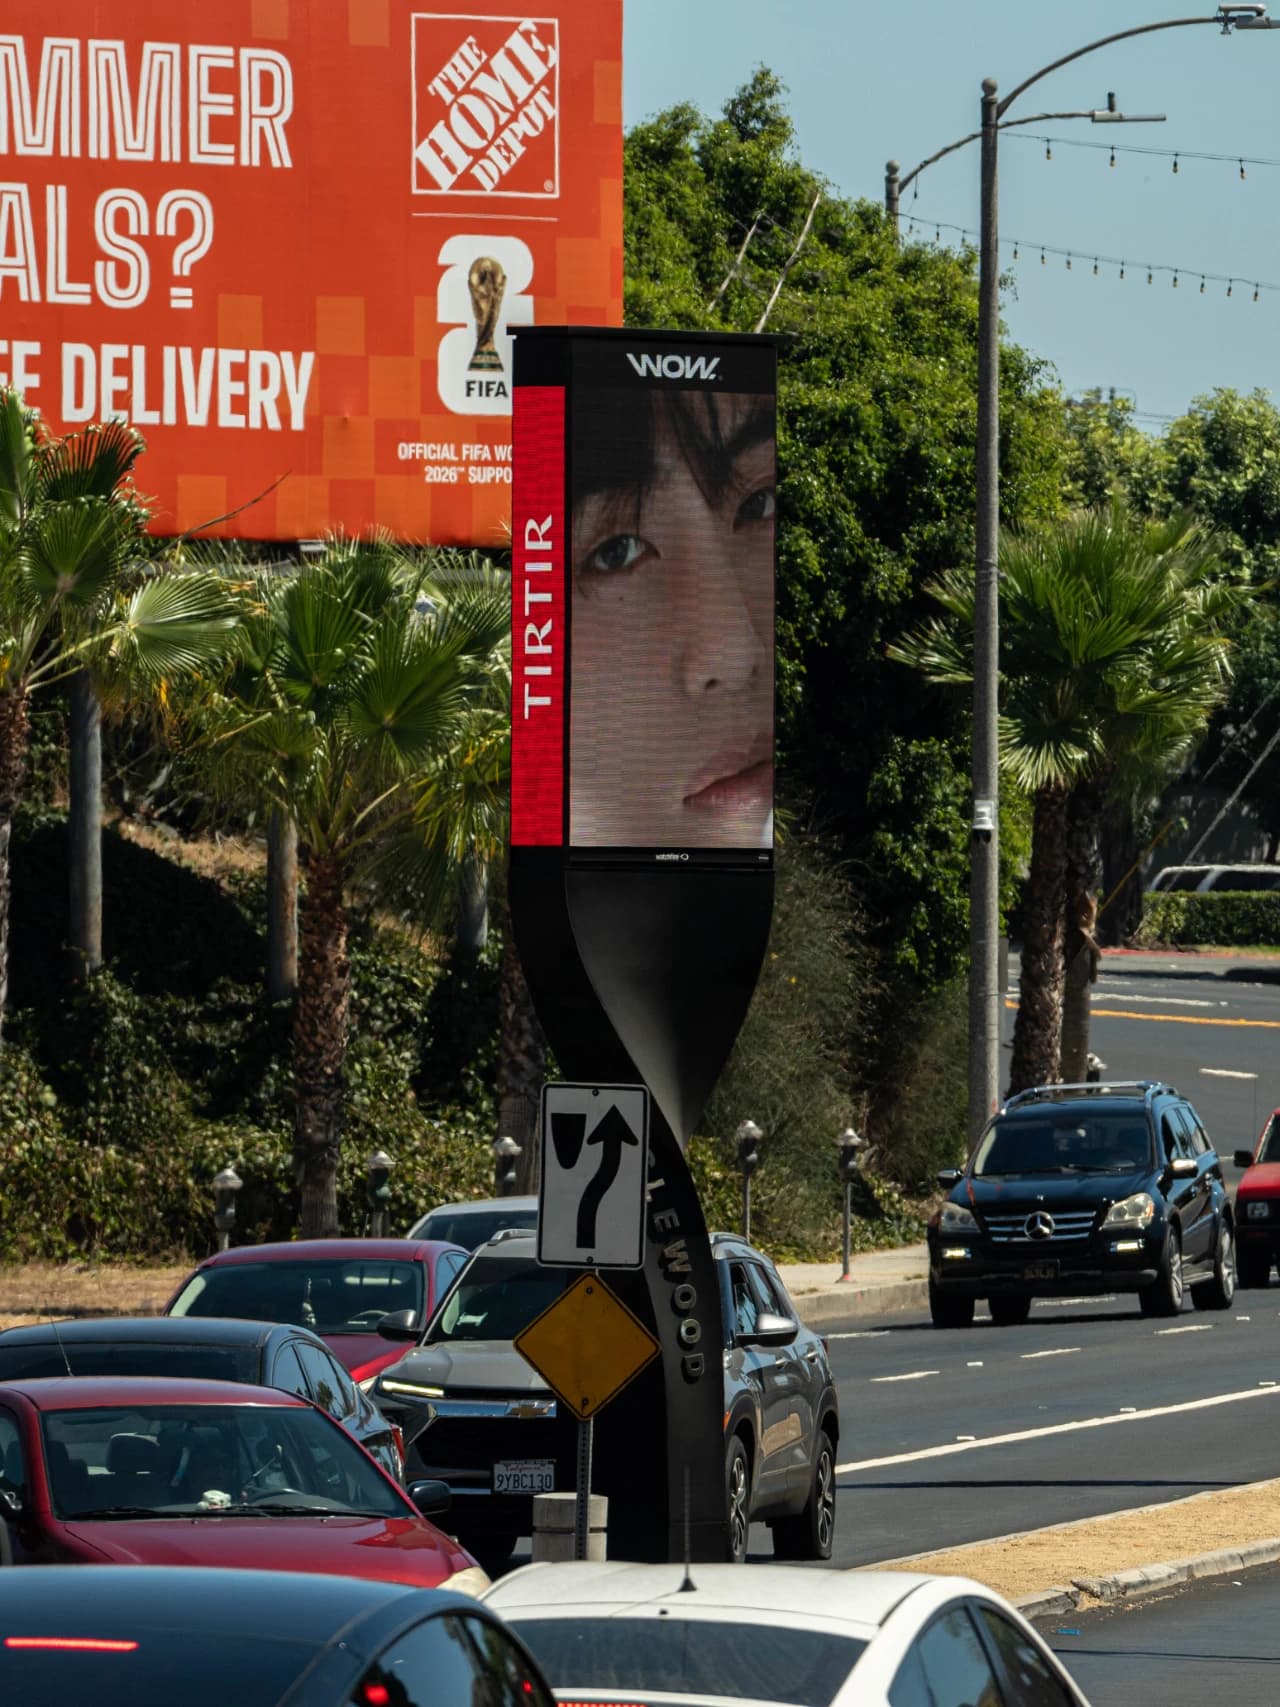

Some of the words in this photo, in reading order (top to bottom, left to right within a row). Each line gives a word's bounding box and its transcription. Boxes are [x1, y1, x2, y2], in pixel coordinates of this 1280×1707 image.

[0, 34, 293, 168] MMER
[415, 19, 558, 192] HOME
[427, 35, 488, 106] THE
[470, 85, 556, 192] DEPOT
[0, 182, 214, 309] ALS?
[61, 341, 315, 431] DELIVERY
[465, 380, 508, 398] FIFA
[397, 442, 459, 461] OFFICIAL
[462, 443, 491, 461] FIFA
[468, 466, 513, 484] SUPPO
[524, 515, 552, 720] TIRTIR
[645, 1149, 705, 1377] LEWOOD
[496, 1473, 553, 1489] 9YBC130
